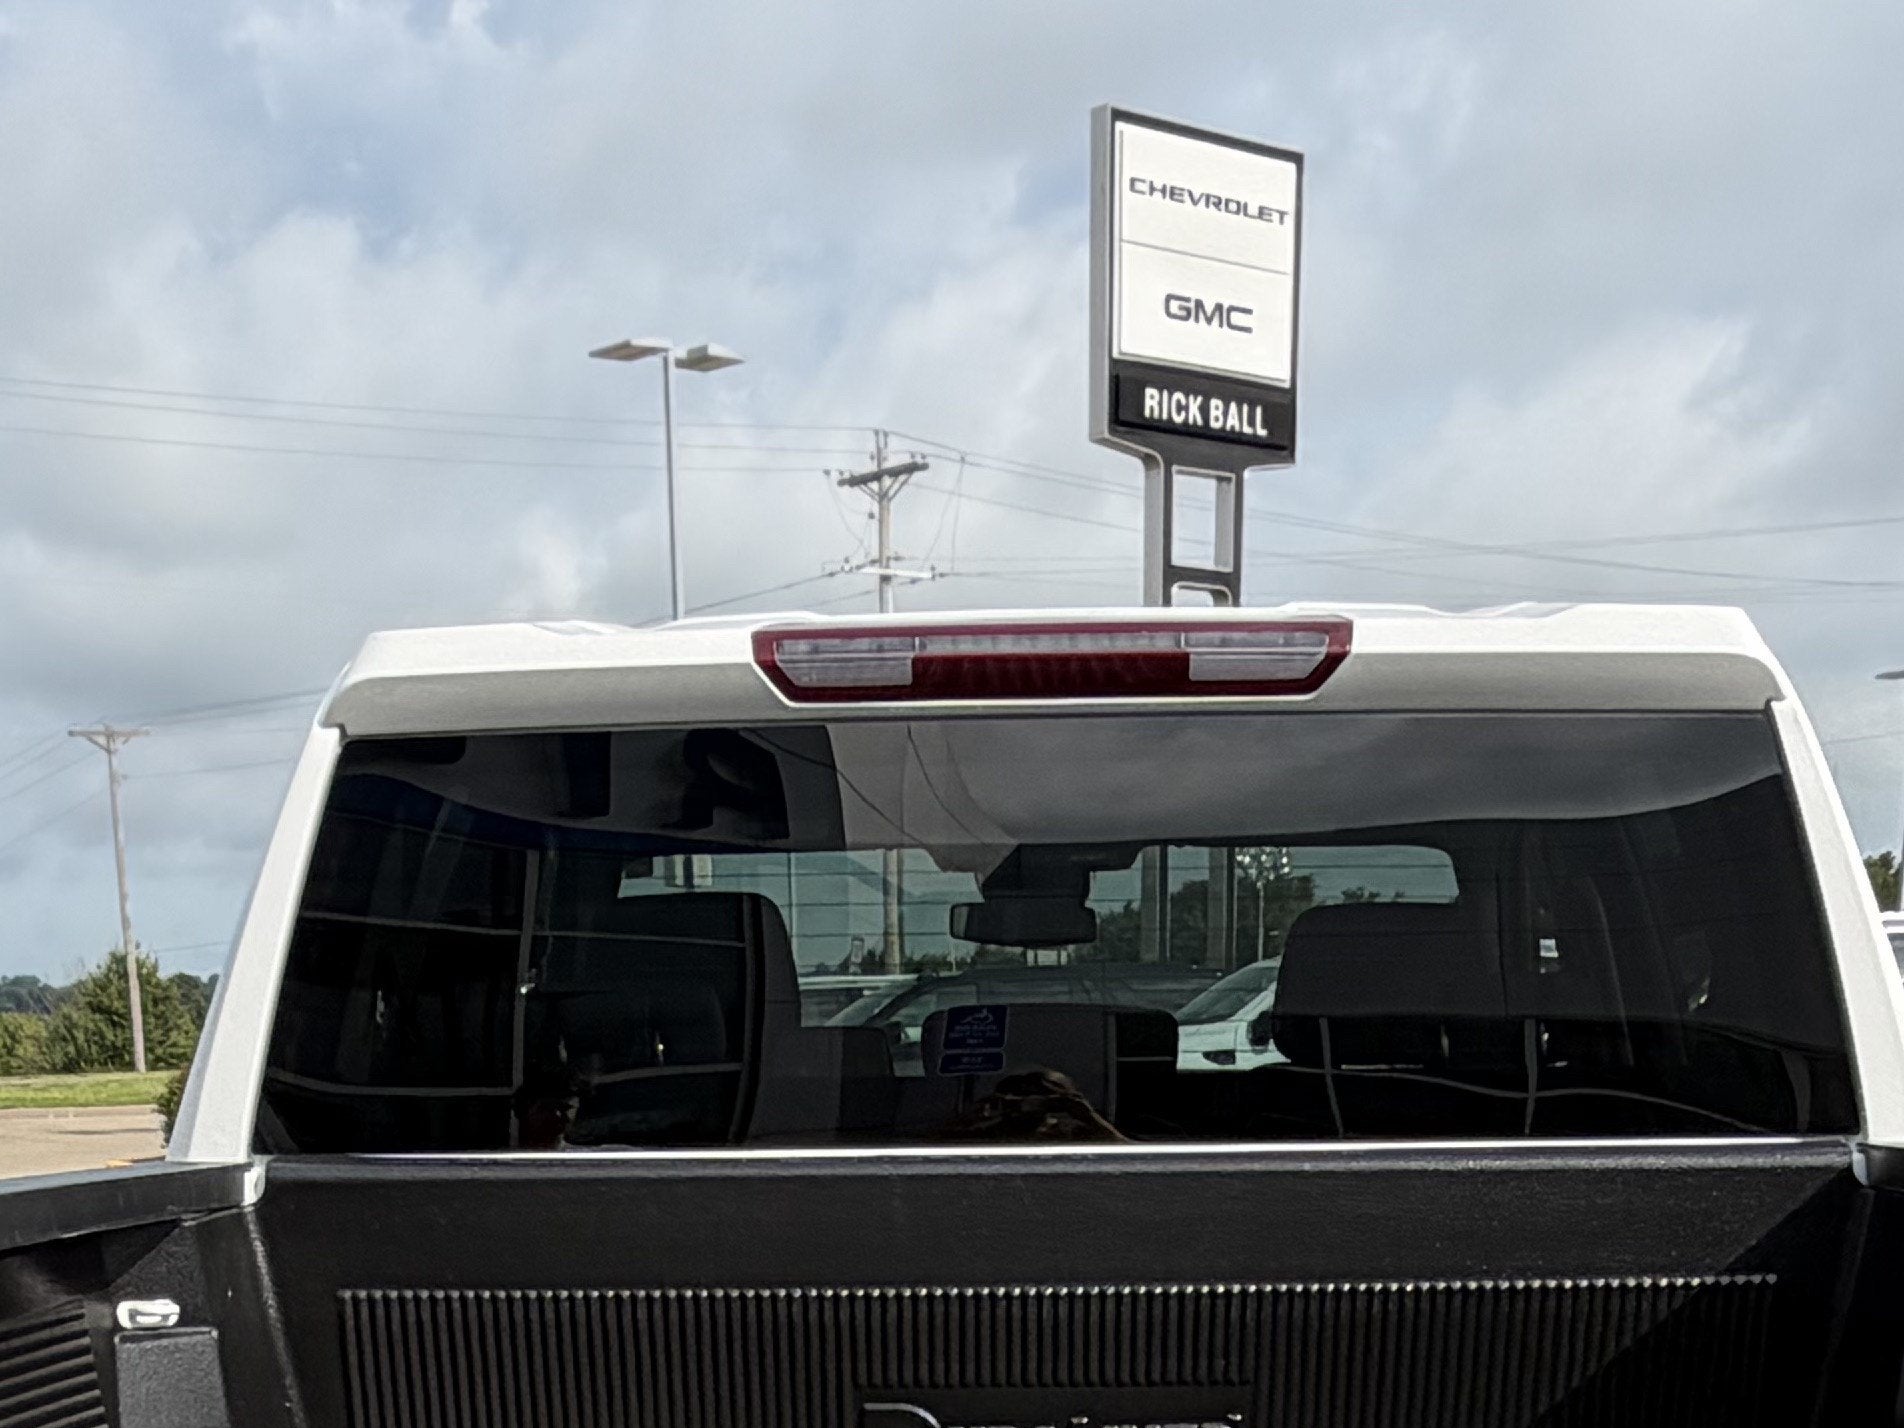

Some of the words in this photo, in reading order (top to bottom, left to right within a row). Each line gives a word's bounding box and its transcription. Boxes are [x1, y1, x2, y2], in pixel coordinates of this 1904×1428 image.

[1128, 176, 1290, 227] CHEVROLET
[1164, 293, 1254, 334] GMC
[1143, 387, 1203, 427] RICK
[1209, 398, 1269, 437] BALL
